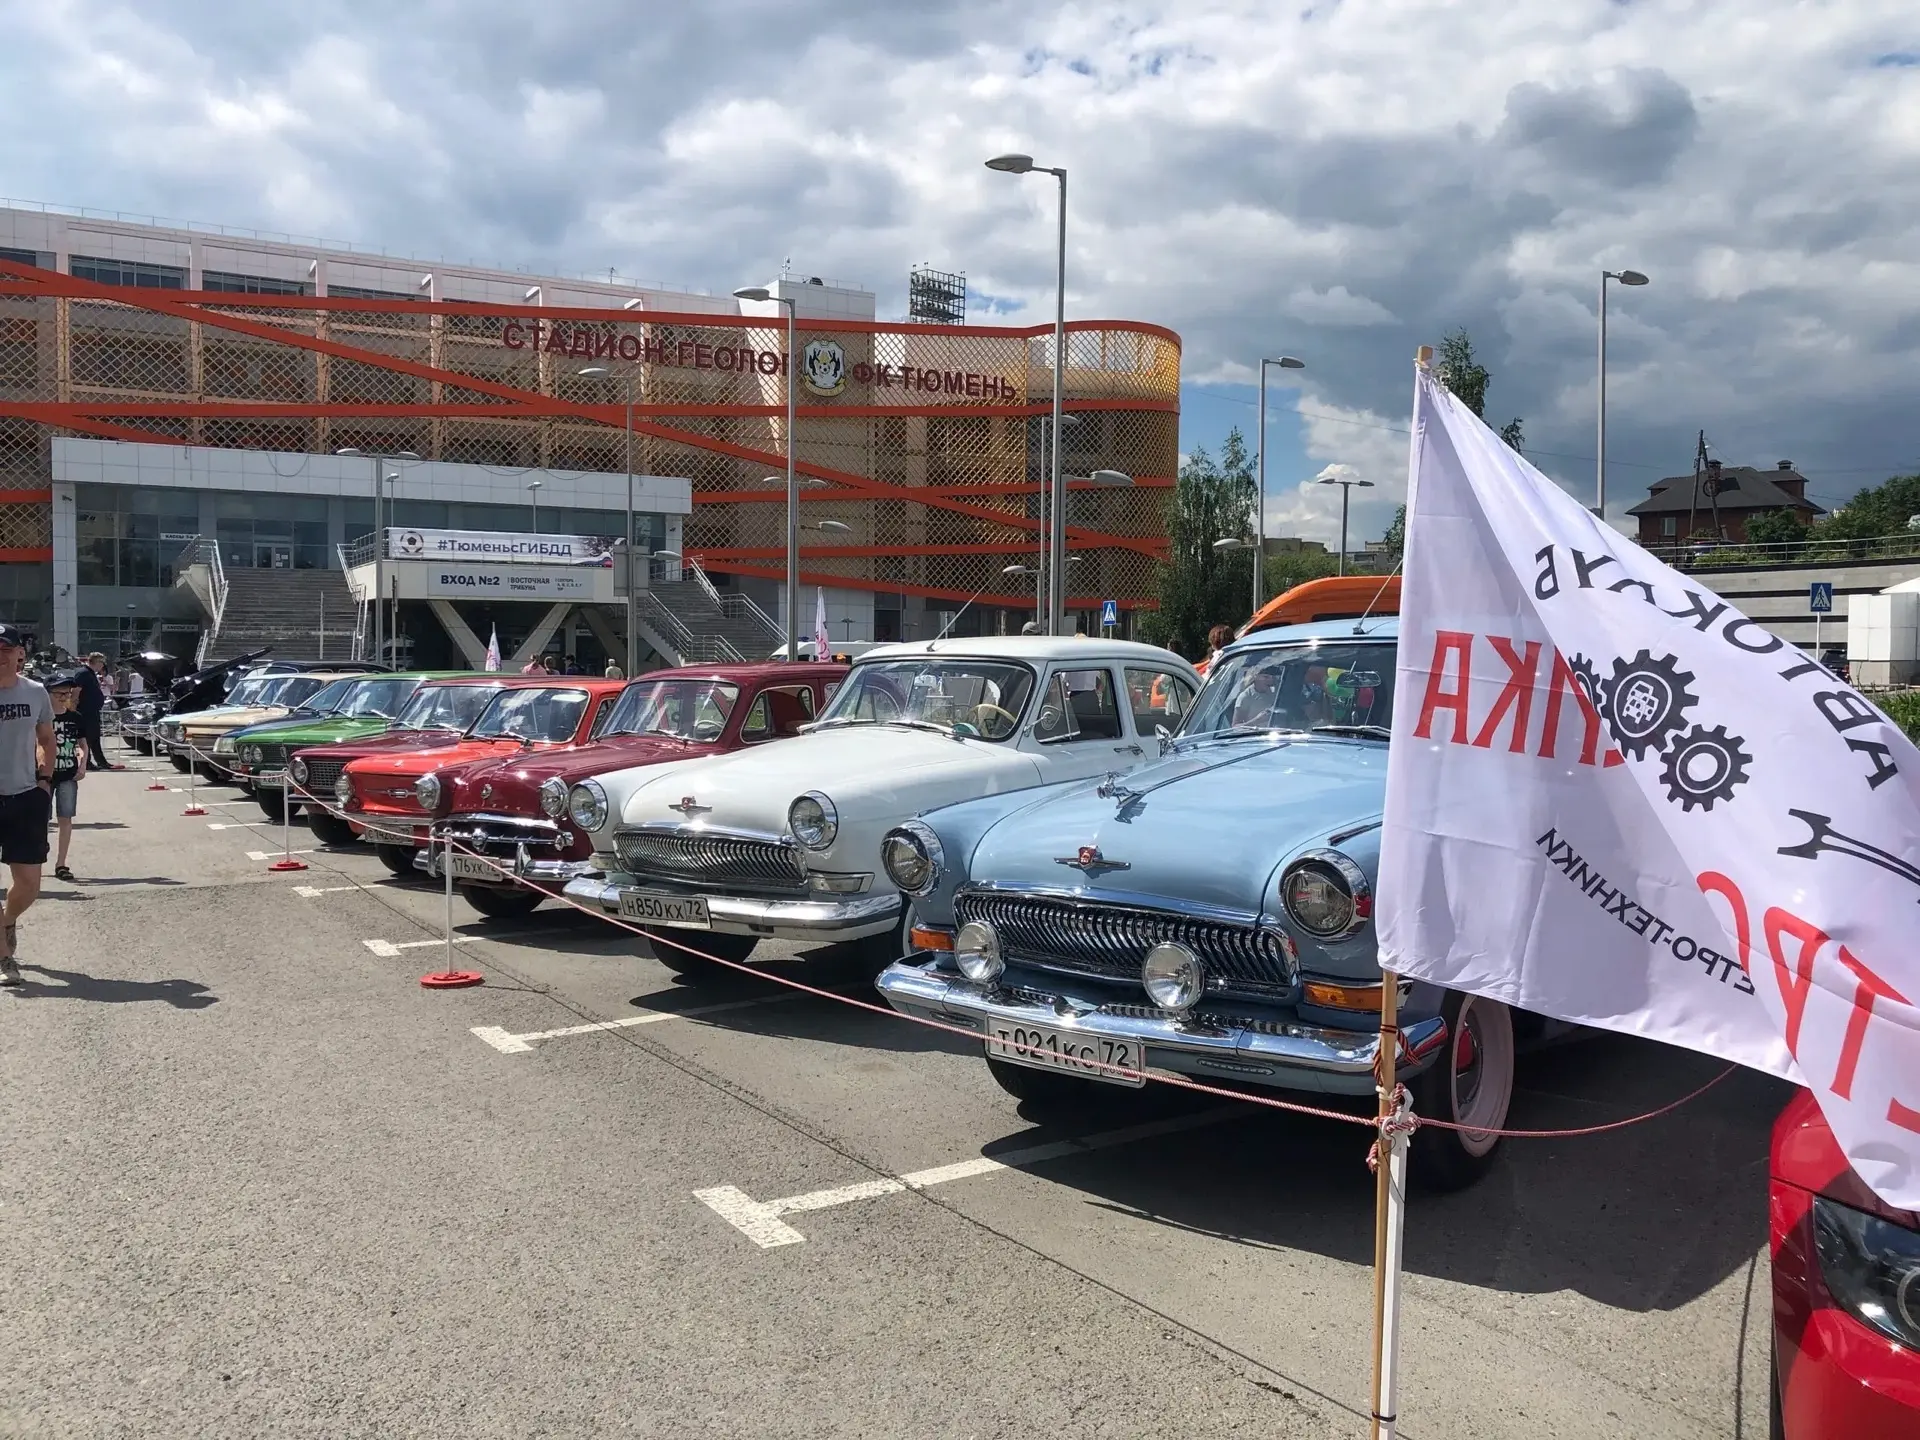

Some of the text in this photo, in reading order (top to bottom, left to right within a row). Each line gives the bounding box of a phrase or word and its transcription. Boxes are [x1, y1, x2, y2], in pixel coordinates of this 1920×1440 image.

[502, 322, 664, 364] СТАДИОН
[852, 361, 1017, 400] ФК ТЮМЕНЬ
[437, 540, 572, 556] #ТюменьсГИБДД
[441, 575, 500, 586] ВХОД №2
[626, 898, 702, 919] Н850КХ 72
[998, 1027, 1130, 1068] Т021КС 72
